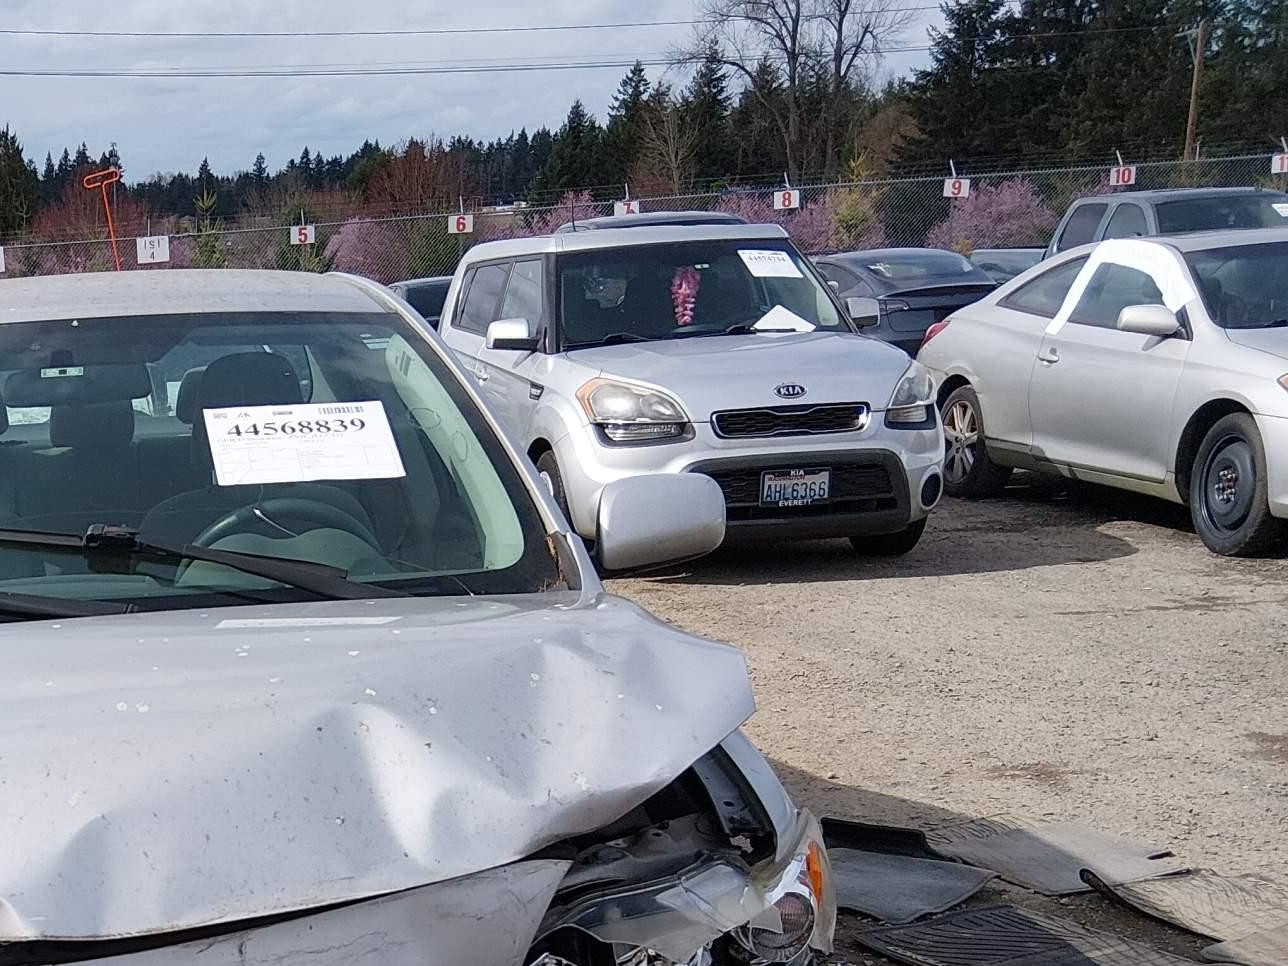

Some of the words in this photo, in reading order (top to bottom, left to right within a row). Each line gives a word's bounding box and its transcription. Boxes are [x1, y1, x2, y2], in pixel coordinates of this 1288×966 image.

[1114, 167, 1132, 184] 10
[951, 180, 962, 196] 9
[622, 201, 632, 215] 7
[782, 191, 792, 208] 8
[456, 215, 466, 232] 6
[298, 226, 308, 243] 5
[779, 386, 802, 395] KIA
[227, 417, 366, 437] 44568839
[779, 499, 812, 507] EVERETT
